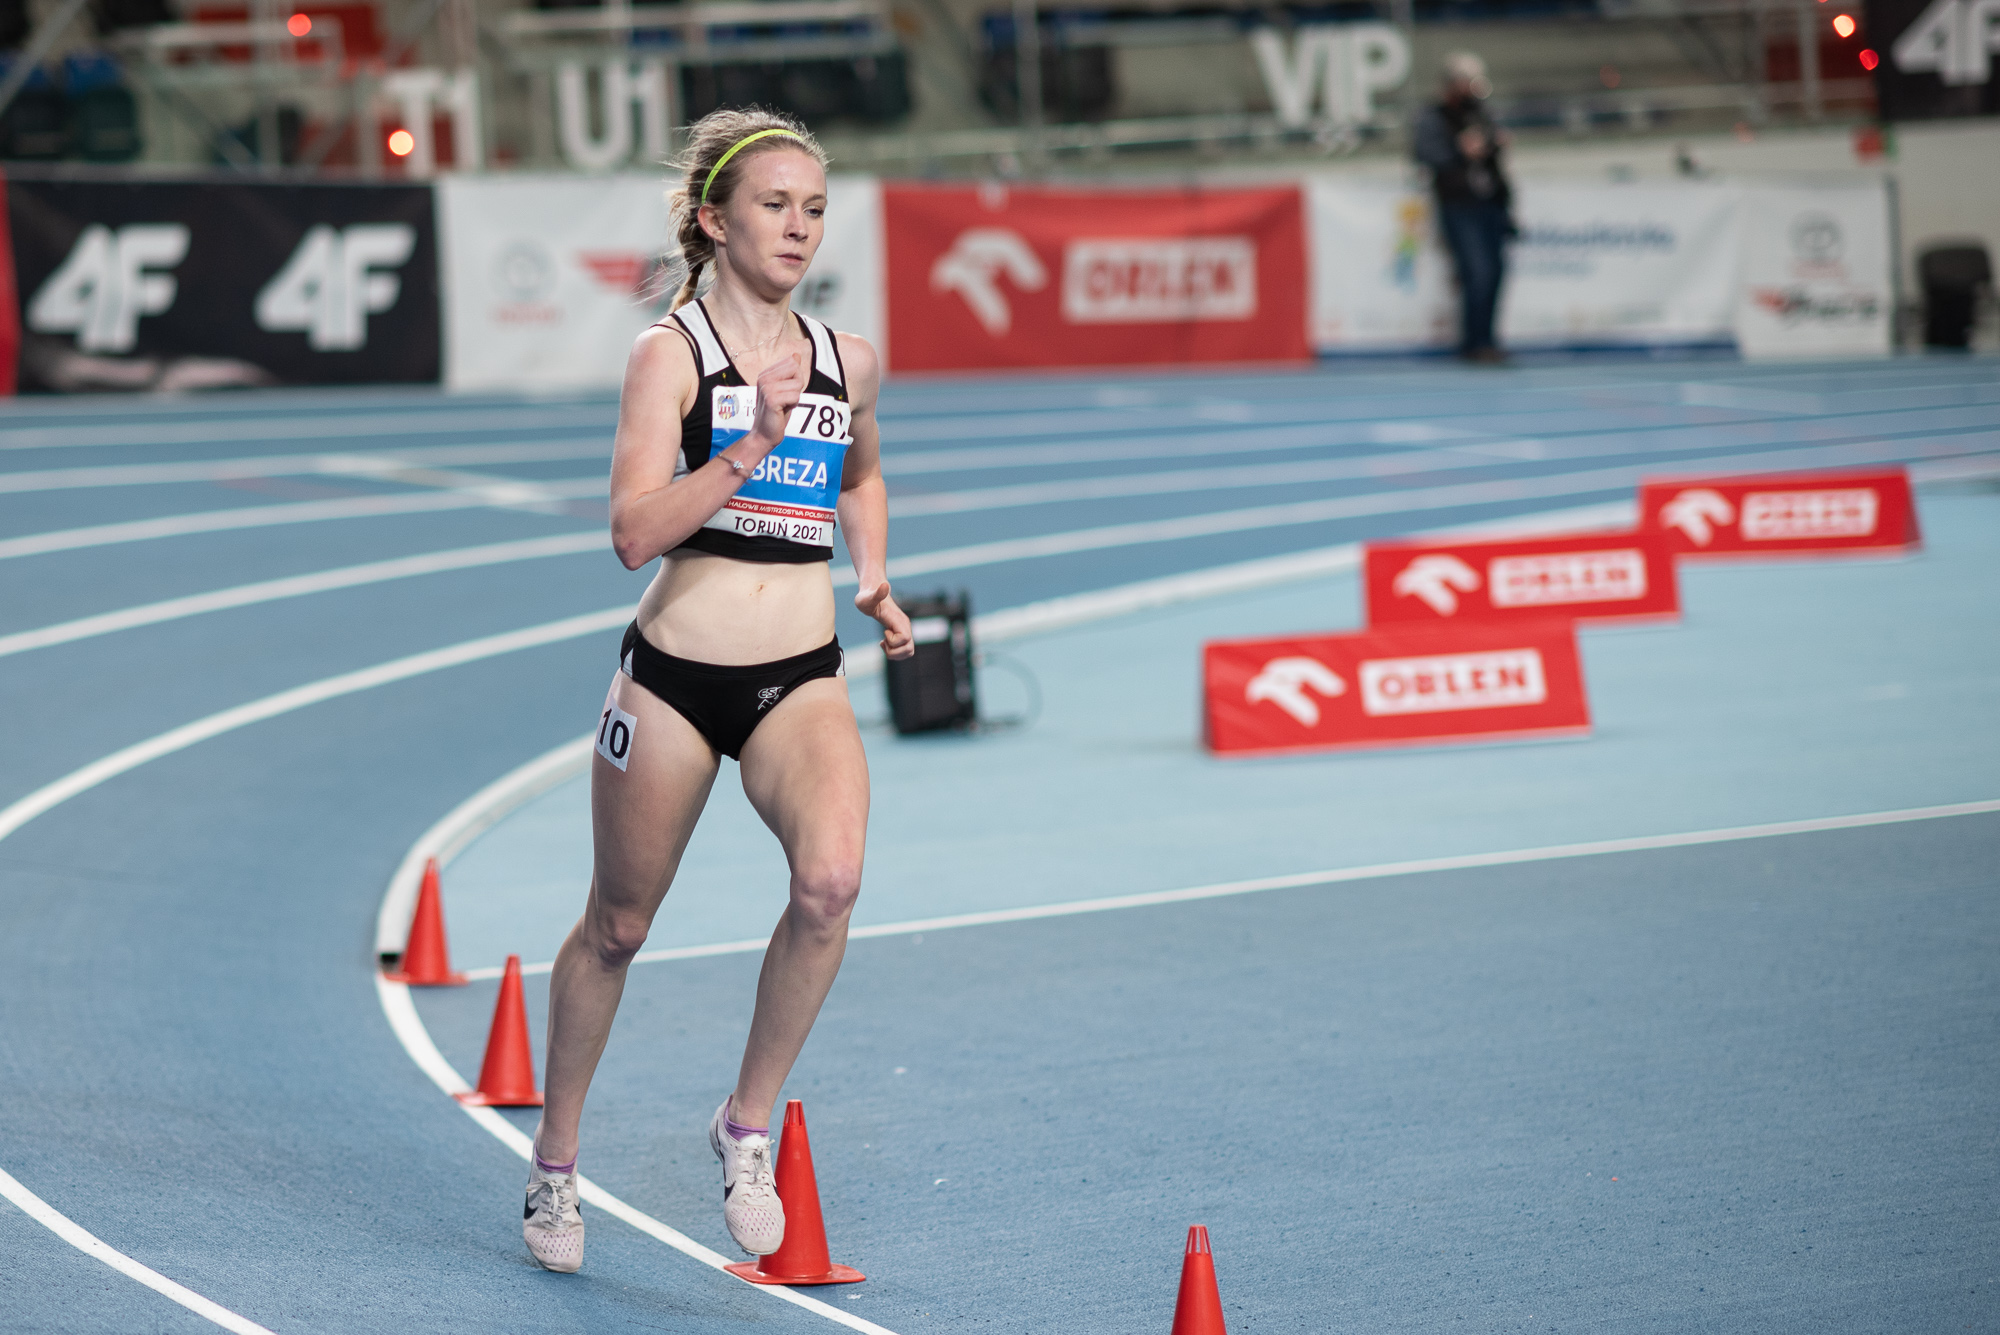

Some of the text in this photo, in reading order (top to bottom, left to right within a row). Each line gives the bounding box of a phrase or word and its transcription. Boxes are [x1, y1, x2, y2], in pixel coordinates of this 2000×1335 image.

[1252, 22, 1411, 127] VIP
[26, 222, 192, 353] 4F
[253, 222, 418, 352] 4F
[728, 501, 759, 511] HALOWE
[759, 505, 804, 517] MISTRZOSTWA
[734, 516, 823, 542] TORUŃ 2021
[599, 707, 631, 760] 10
